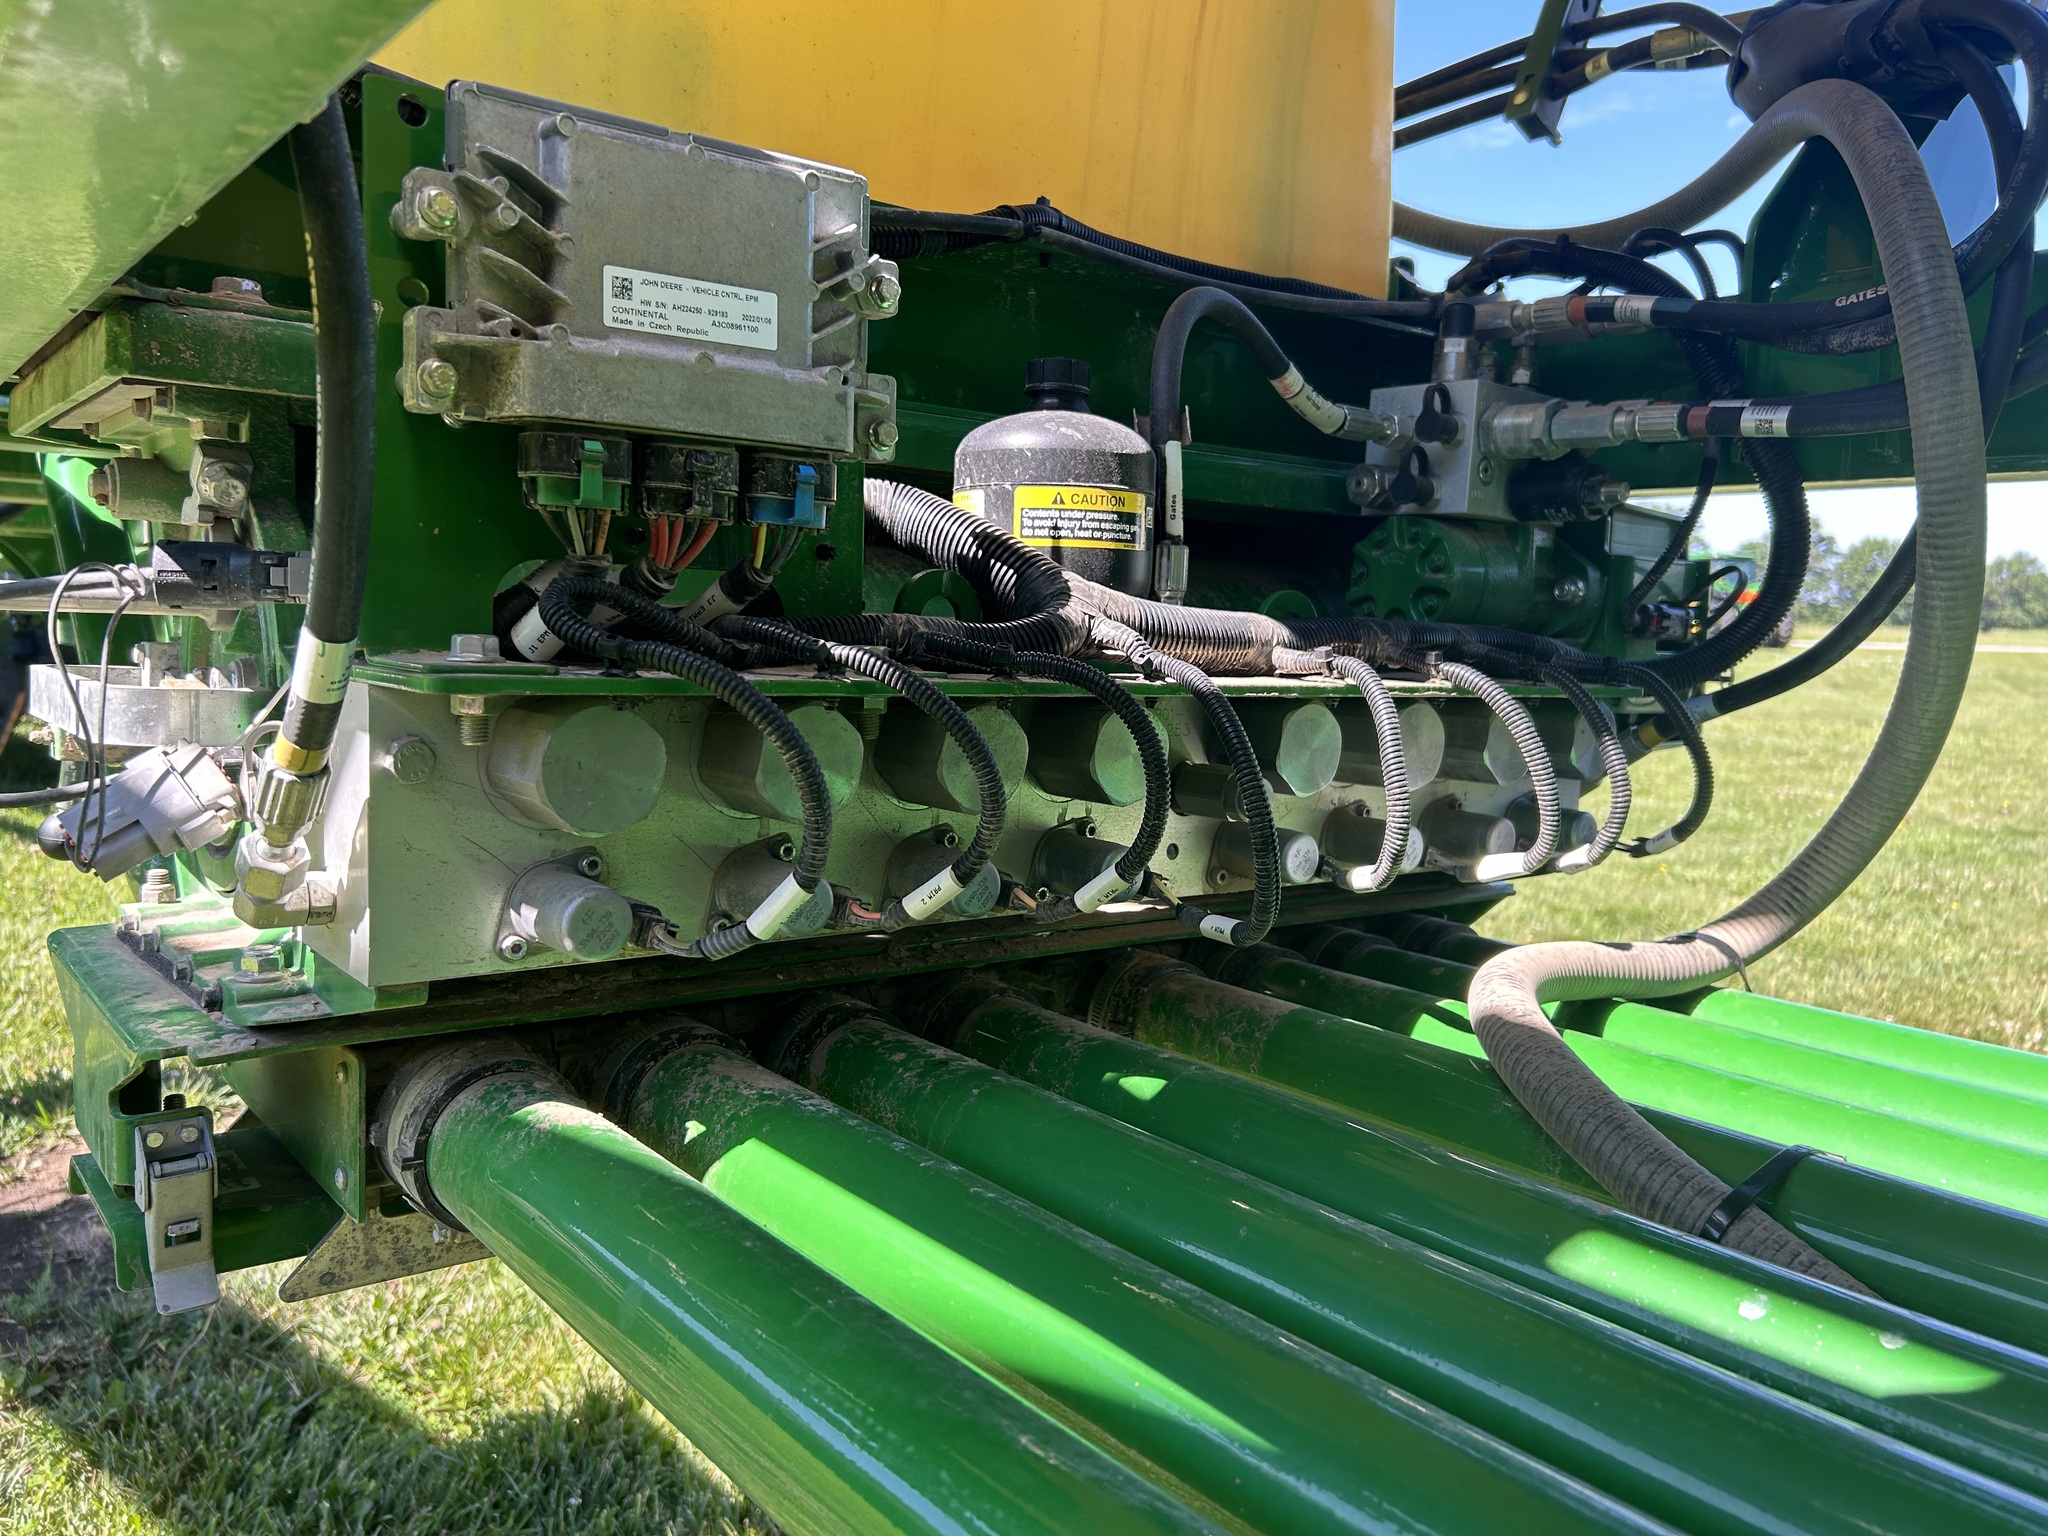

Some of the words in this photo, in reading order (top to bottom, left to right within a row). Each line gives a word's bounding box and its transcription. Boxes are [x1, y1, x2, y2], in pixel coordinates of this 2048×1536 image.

[640, 278, 659, 288] JOHN
[660, 281, 683, 292] DEERE
[692, 286, 719, 297] VEHICLE
[720, 291, 744, 302] CNTRL,
[745, 294, 759, 303] EPM
[1834, 284, 1888, 307] GATES
[640, 299, 652, 307] HW
[655, 301, 669, 310] S/N:
[612, 305, 669, 321] CONTINENTAL
[612, 316, 633, 326] Made
[637, 319, 645, 328] in
[649, 321, 672, 331] Czech
[676, 325, 709, 337] Republic
[1070, 493, 1126, 508] CAUTION
[1022, 508, 1060, 518] Contents
[1060, 509, 1085, 519] under
[1086, 511, 1120, 521] pressure.
[1022, 517, 1033, 527] To
[1033, 518, 1056, 527] avoid
[1057, 519, 1081, 530] injury
[1081, 520, 1100, 529] from
[1100, 522, 1129, 533] escaping
[1021, 527, 1034, 536] do
[1034, 528, 1049, 536] not
[1050, 529, 1074, 539] open,
[1074, 530, 1092, 538] heat
[1102, 531, 1133, 540] puncture.
[706, 594, 716, 606] J3
[528, 644, 538, 654] J1
[667, 705, 690, 723] A2
[926, 885, 942, 901] PRIM
